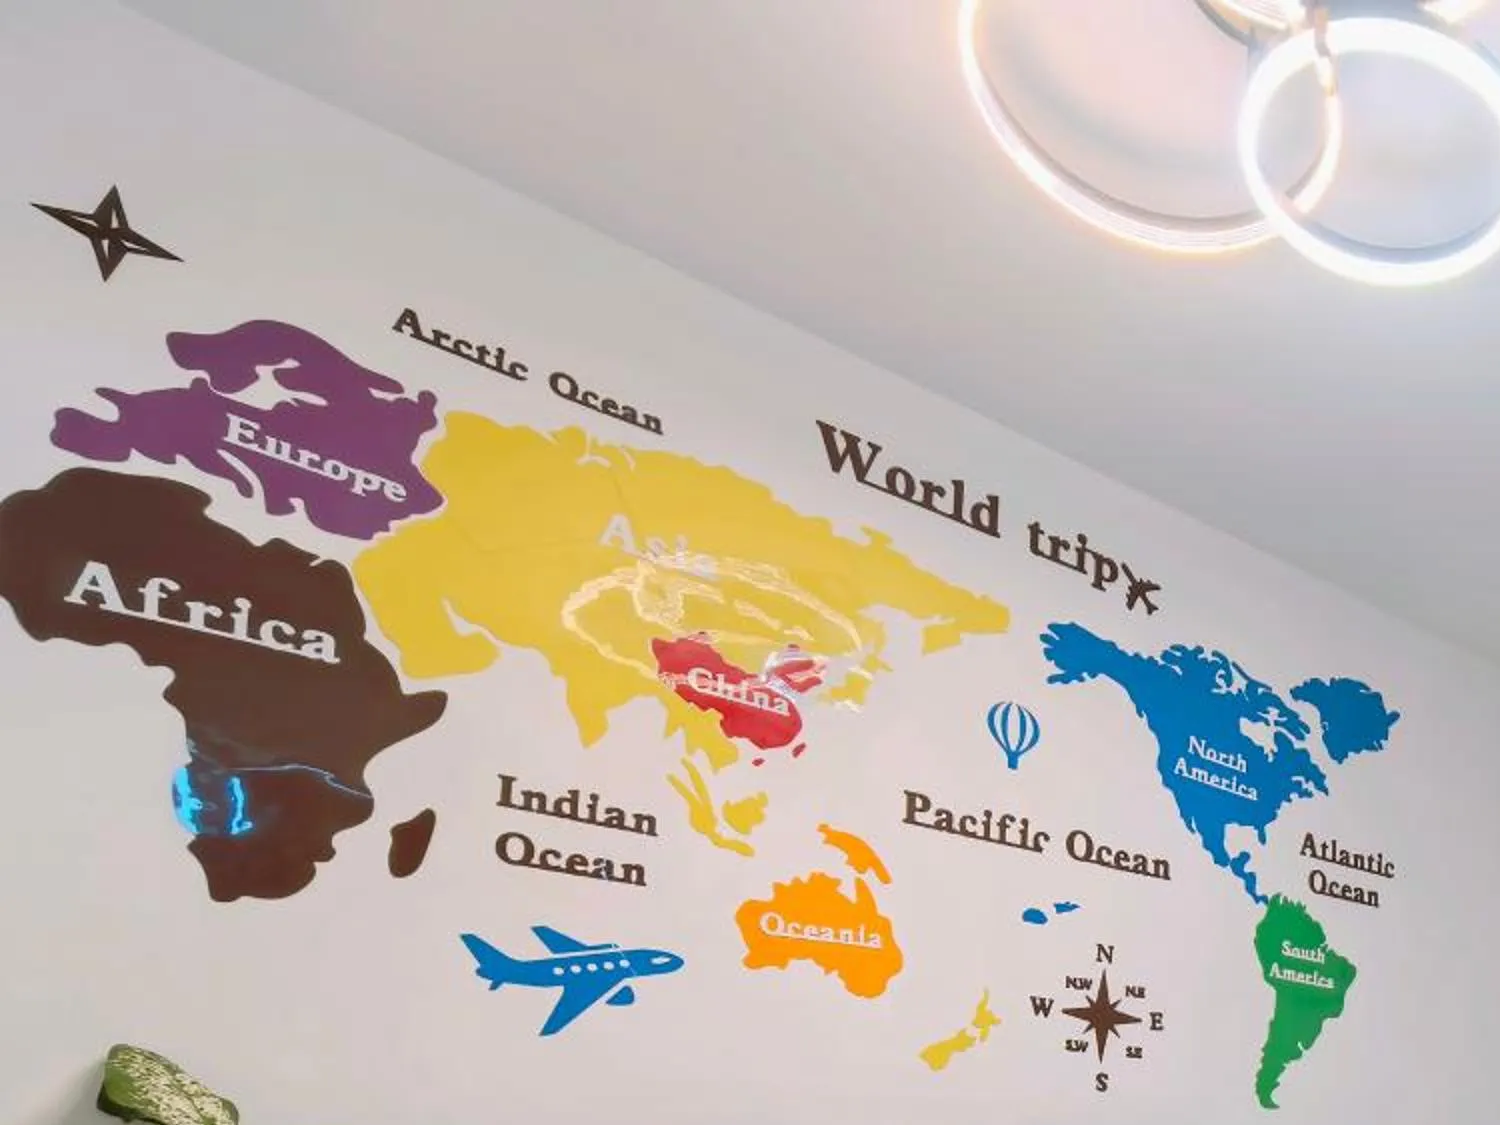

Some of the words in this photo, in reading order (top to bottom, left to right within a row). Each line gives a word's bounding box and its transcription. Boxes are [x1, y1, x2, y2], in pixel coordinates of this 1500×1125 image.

[392, 307, 529, 382] Arctic
[549, 370, 663, 435] Ocean
[223, 412, 407, 503] Europe
[816, 420, 1000, 537] World
[1027, 520, 1119, 591] trip
[64, 560, 340, 664] Africa
[686, 667, 790, 716] China
[1188, 735, 1247, 773] North
[1174, 757, 1257, 801] America
[496, 774, 658, 837] Indian
[903, 789, 1050, 854] Pacific
[1066, 829, 1171, 881] Ocean
[1300, 831, 1395, 879] Atlantic
[495, 832, 647, 886] Ocean
[1308, 869, 1379, 908] Ocean
[760, 912, 882, 949] Oceania
[1281, 939, 1326, 964] South
[1095, 944, 1115, 964] N
[1269, 961, 1335, 989] America
[1030, 996, 1055, 1018] W
[1149, 1012, 1164, 1031] E
[1095, 1072, 1109, 1092] S
